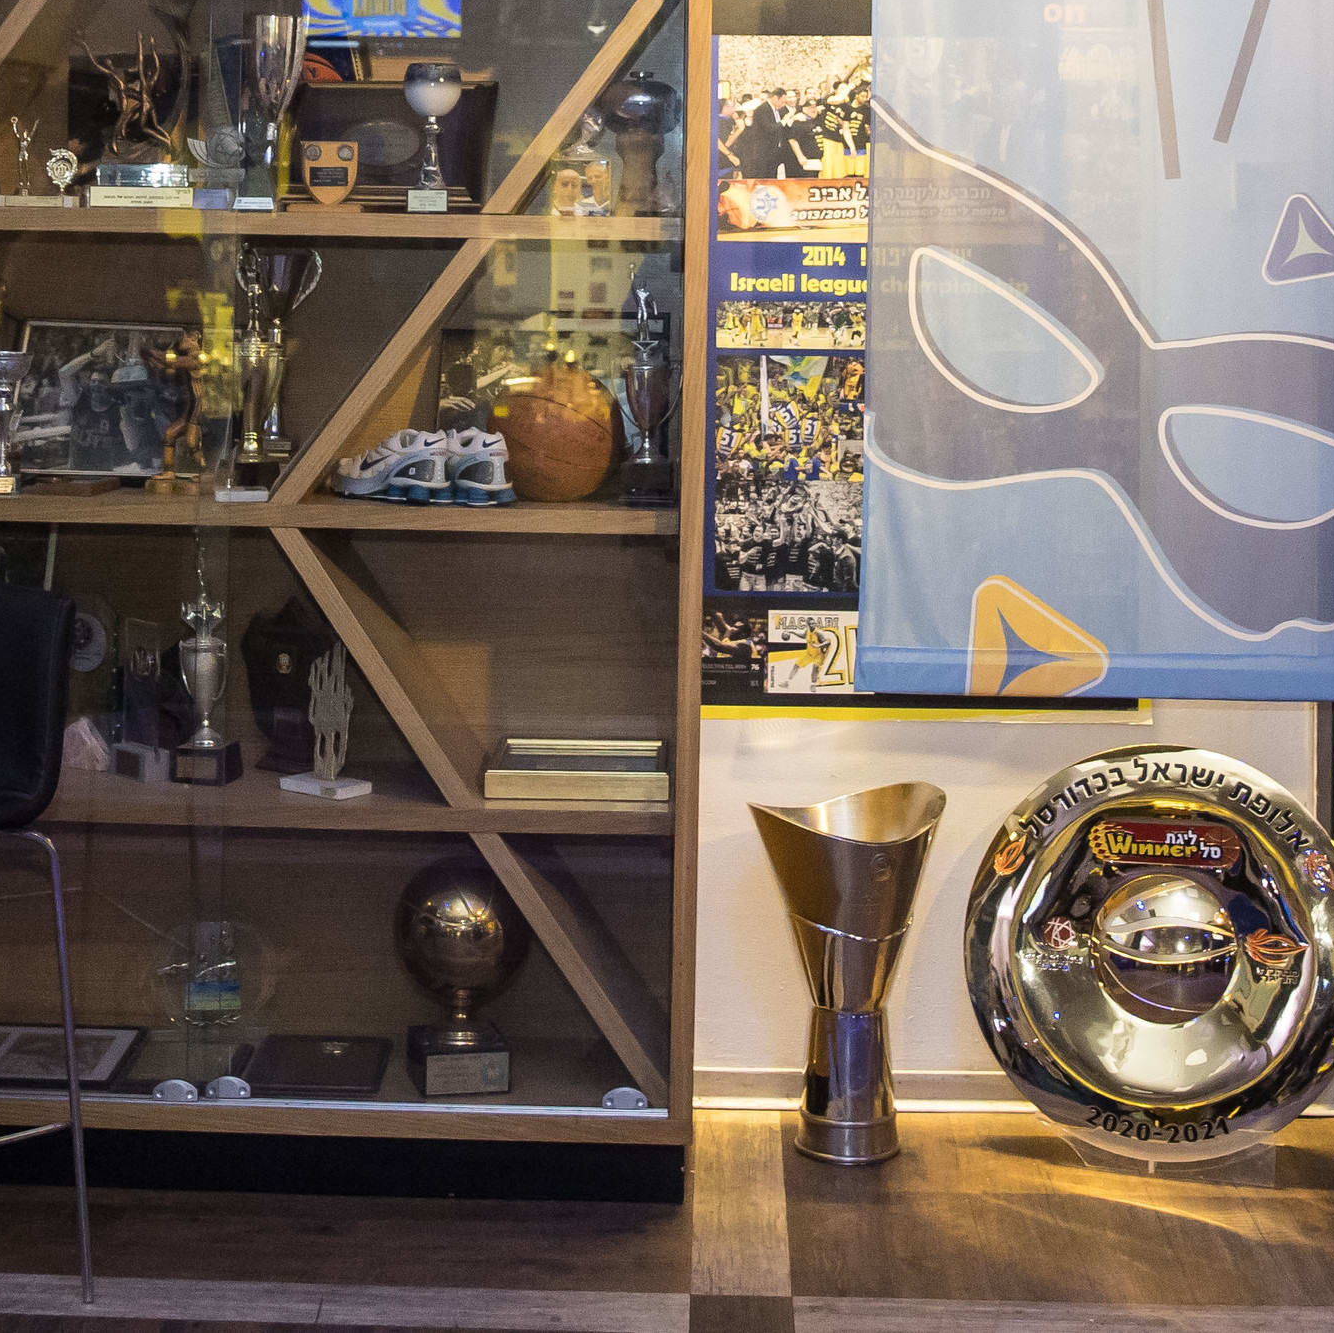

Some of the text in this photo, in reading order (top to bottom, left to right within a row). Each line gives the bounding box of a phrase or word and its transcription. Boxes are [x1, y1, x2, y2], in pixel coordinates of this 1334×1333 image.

[808, 186, 850, 203] אביב
[789, 207, 855, 221] 2013/2014
[802, 245, 846, 266] 2014
[730, 271, 795, 293] Israeli
[775, 616, 839, 631] MACABI
[1018, 756, 1310, 854] אלופת ישראל בכדורסל
[1165, 829, 1198, 845] ליגת
[1199, 842, 1222, 859] סל
[1085, 1106, 1232, 1144] 2020-2021
